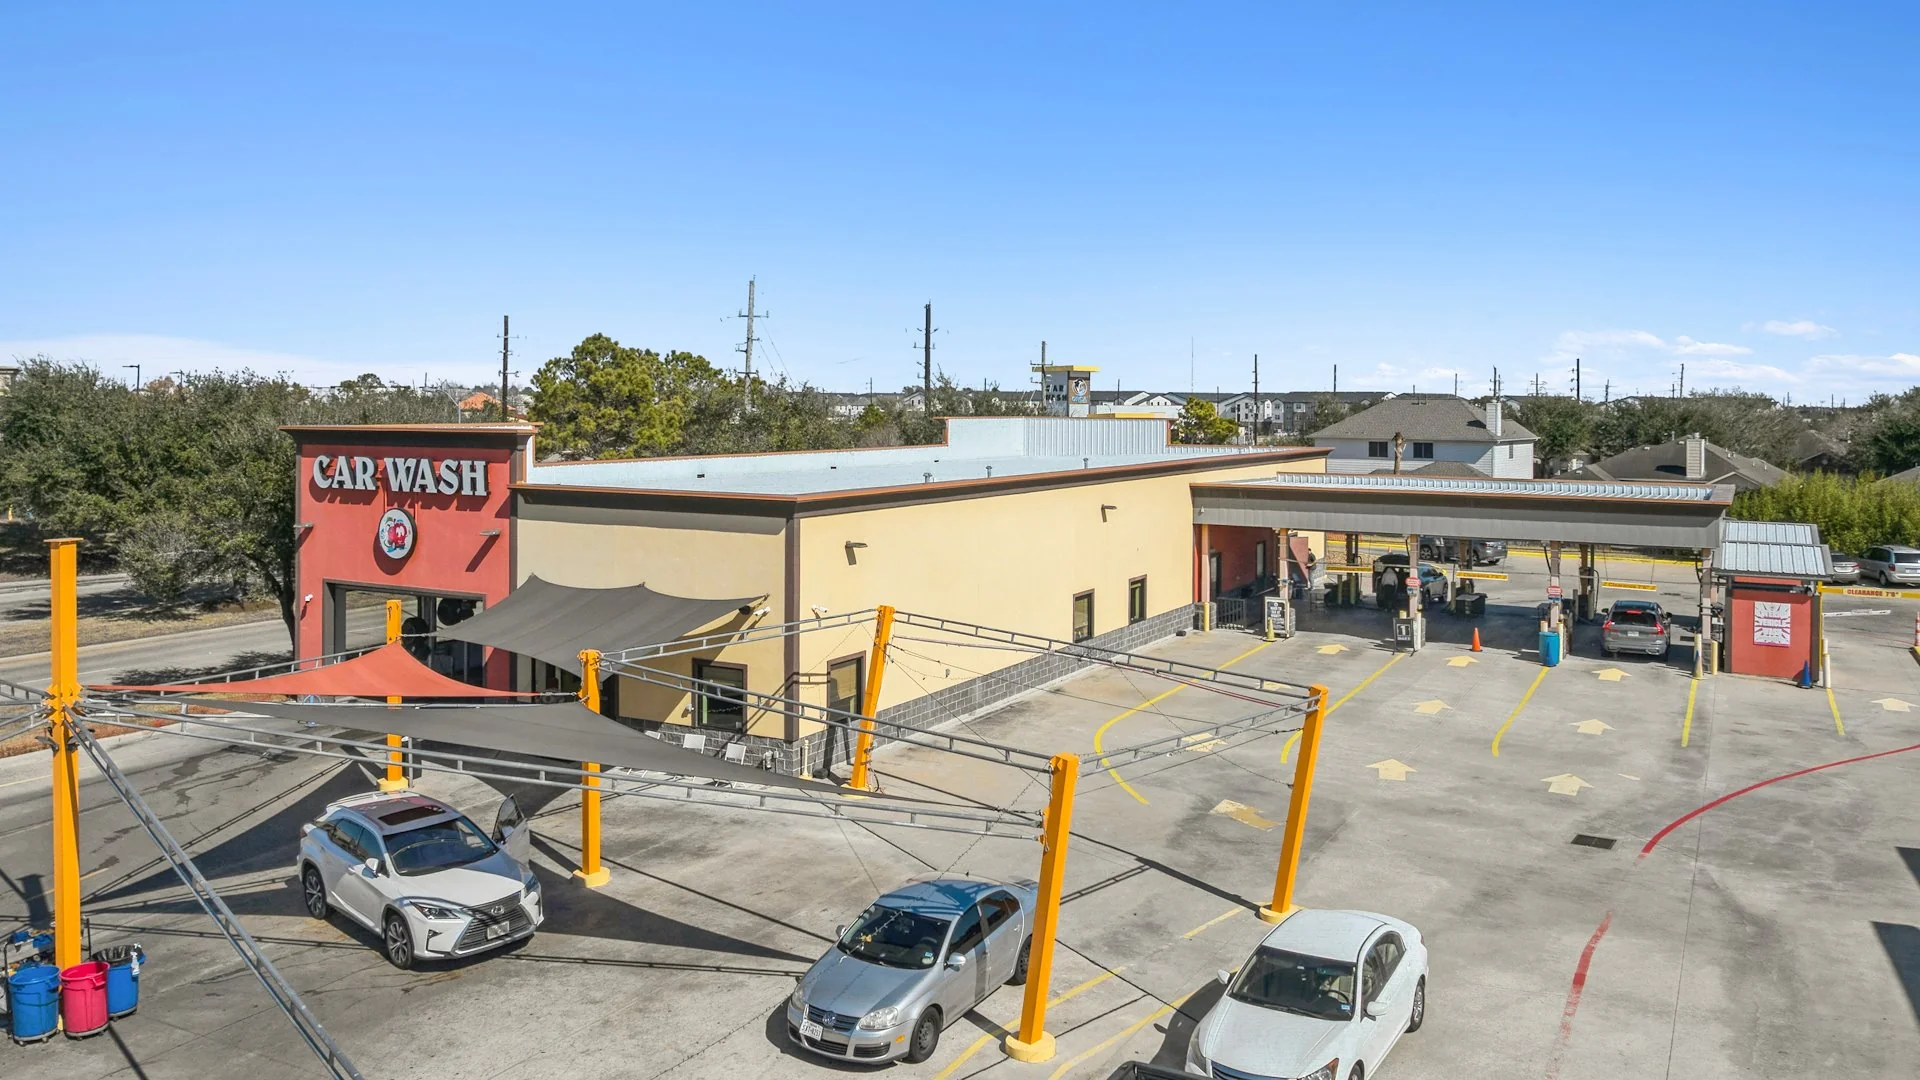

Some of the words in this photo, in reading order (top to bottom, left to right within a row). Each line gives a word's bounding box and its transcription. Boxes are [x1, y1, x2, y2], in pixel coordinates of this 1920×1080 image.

[313, 455, 377, 491] CAR
[384, 457, 488, 497] WASH
[1847, 589, 1883, 597] CLEARANCE
